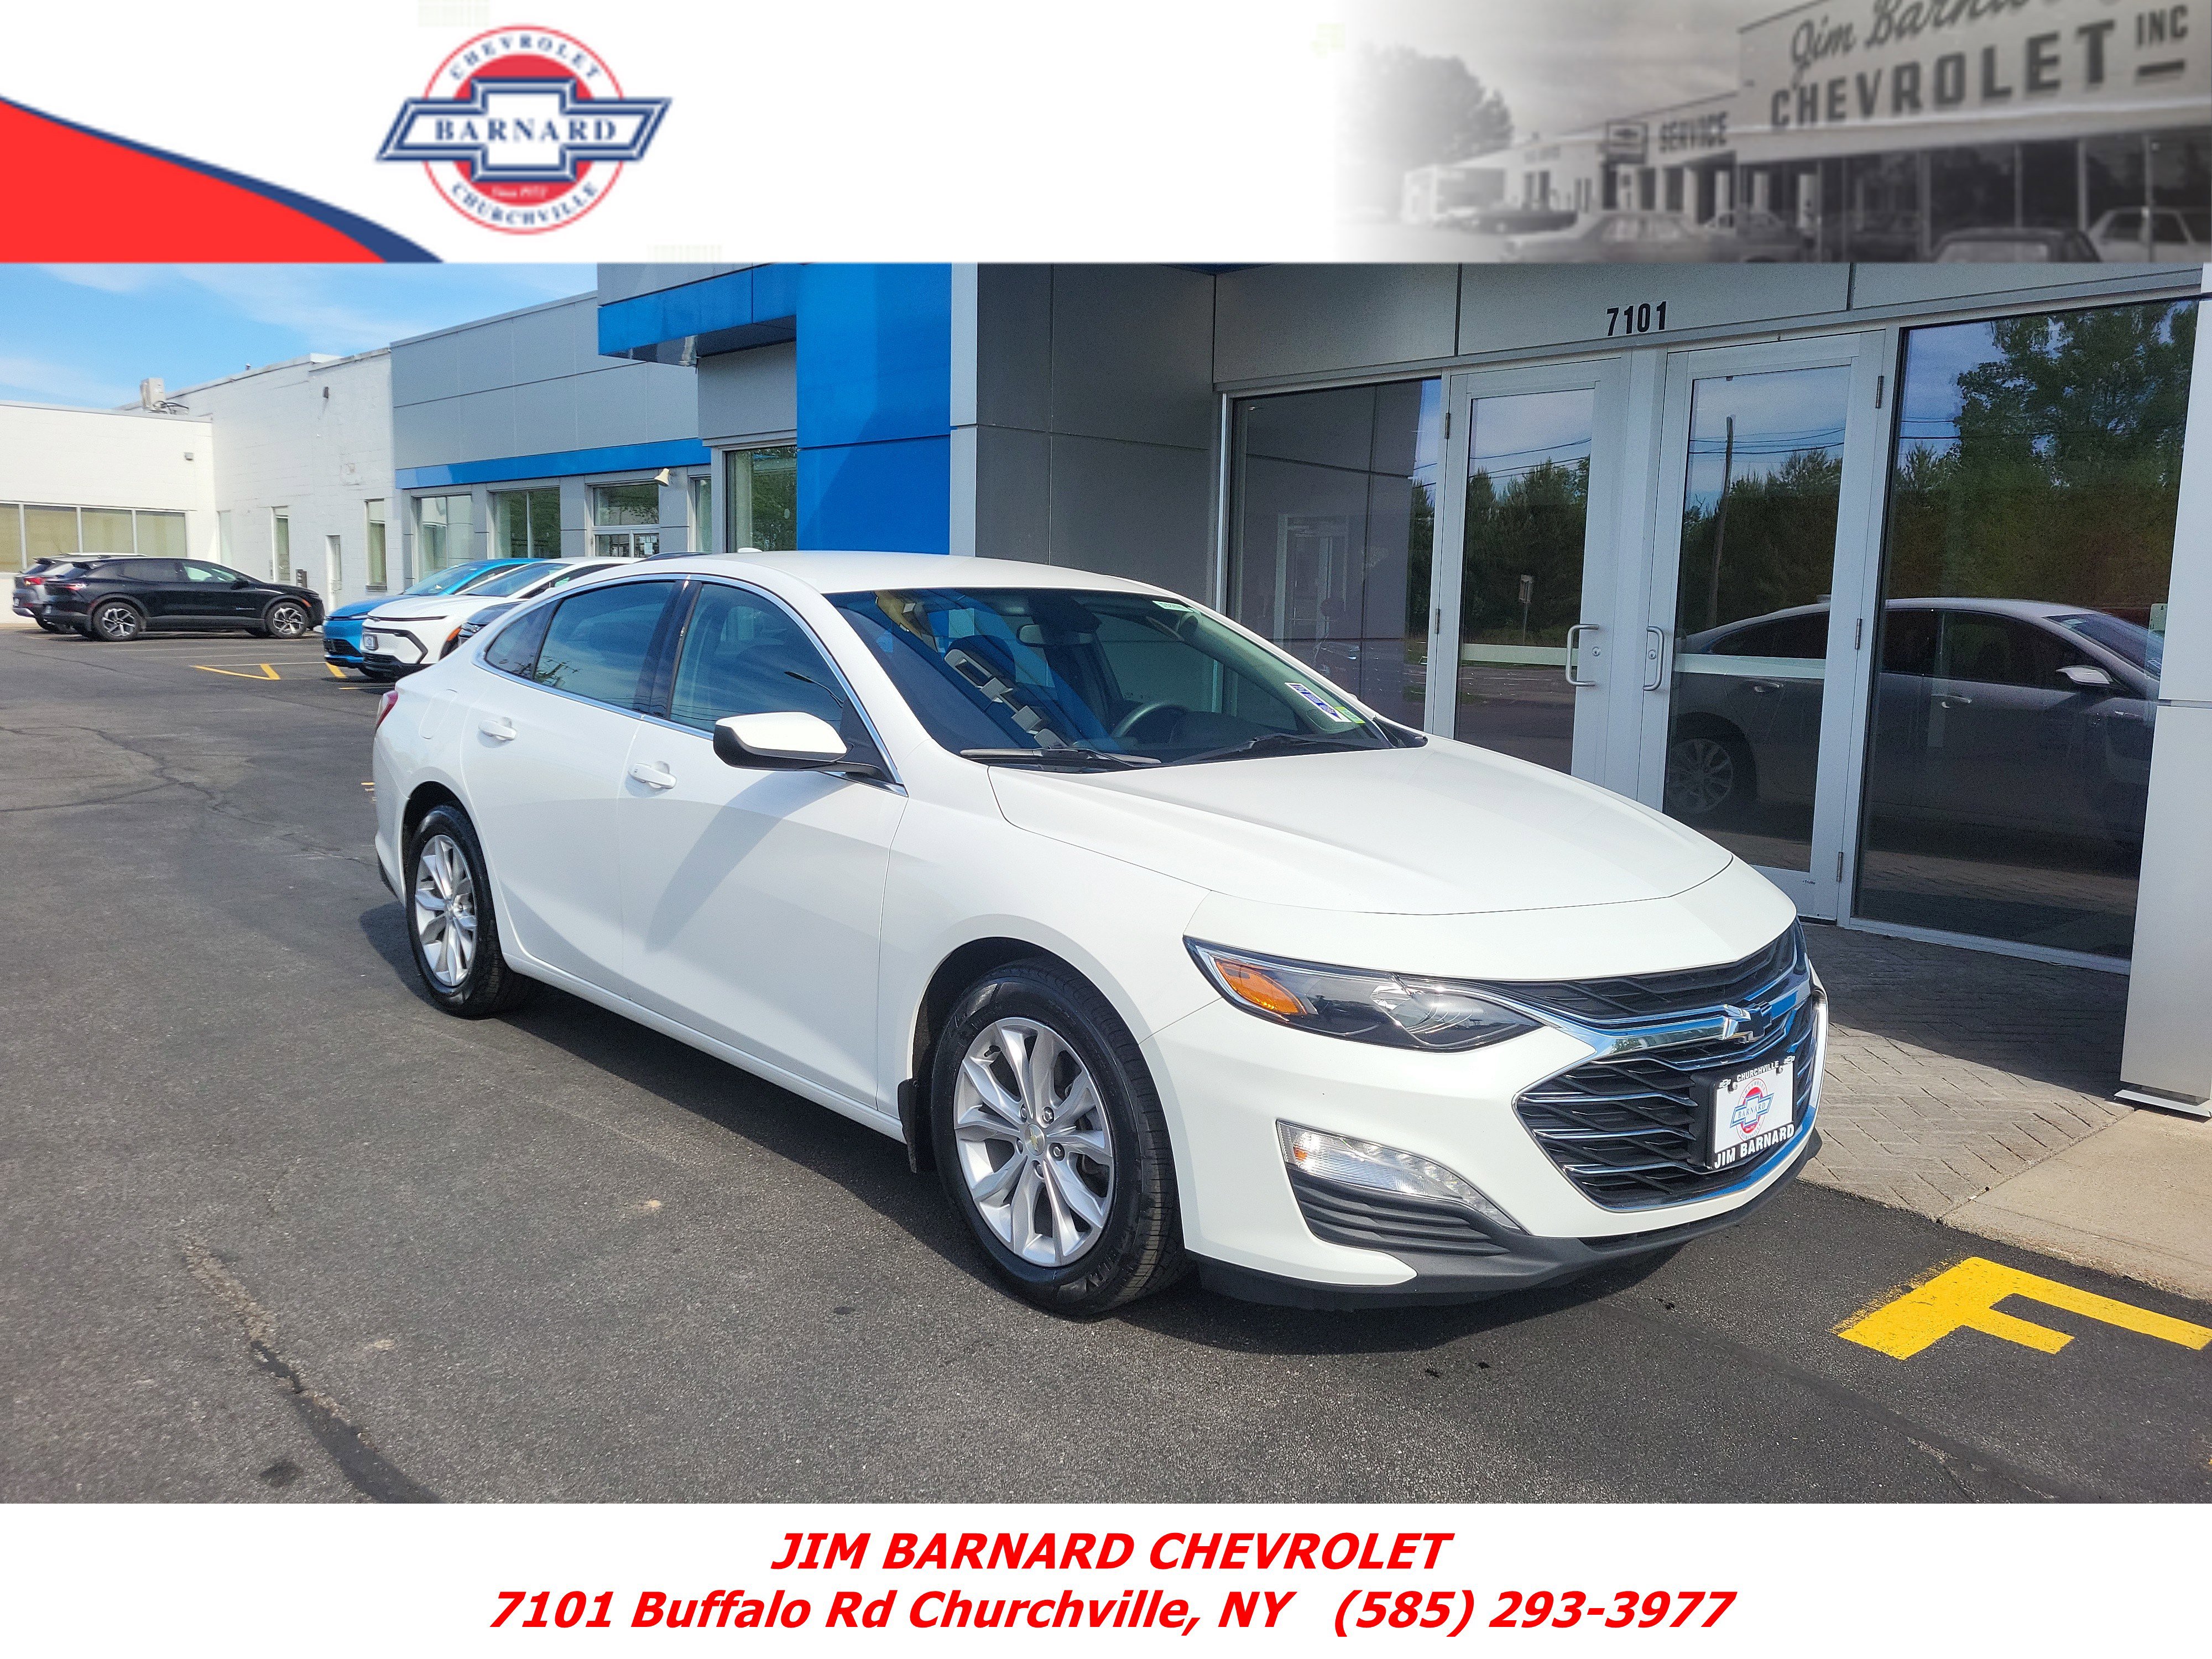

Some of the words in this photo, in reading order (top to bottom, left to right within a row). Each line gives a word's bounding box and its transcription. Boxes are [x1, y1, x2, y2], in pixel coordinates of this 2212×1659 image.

[1606, 301, 1667, 336] 7101
[1736, 1060, 1780, 1082] CHURCHVILLE
[1738, 1102, 1766, 1118] BARNARD
[1714, 1147, 1736, 1169] JIM
[1740, 1124, 1795, 1158] BARNARD
